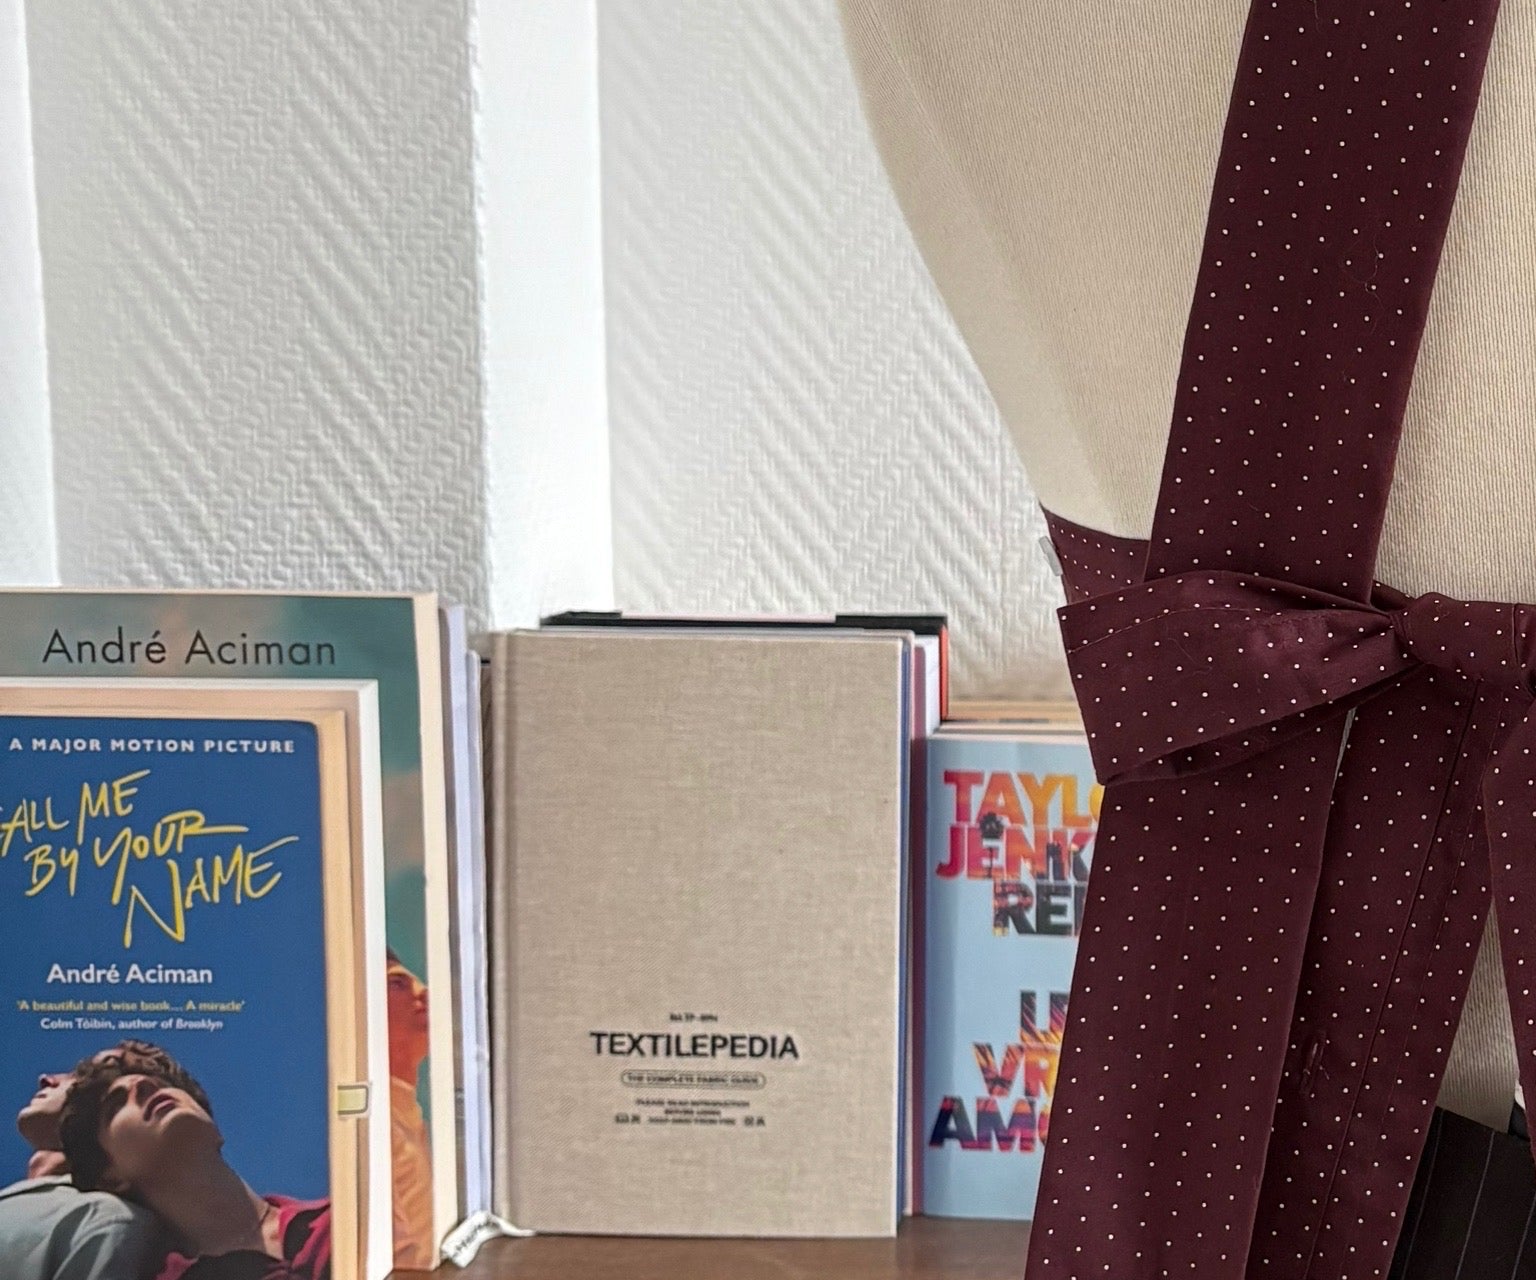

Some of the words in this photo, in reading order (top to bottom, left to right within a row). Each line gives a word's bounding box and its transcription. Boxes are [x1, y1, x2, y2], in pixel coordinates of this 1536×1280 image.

[42, 626, 166, 663] André
[184, 629, 336, 665] Aciman
[9, 738, 22, 751] A
[32, 738, 101, 754] MAJOR
[110, 738, 195, 753] MOTION
[204, 739, 295, 754] PICTURE
[78, 769, 151, 846] ME
[23, 844, 79, 897] BY
[93, 810, 249, 906] YOUR
[123, 836, 300, 949] NAME
[47, 963, 120, 984] André
[125, 963, 213, 984] Aciman
[32, 1000, 84, 1012] beautiful
[86, 1000, 108, 1012] and
[111, 1001, 138, 1012] wise
[185, 1001, 196, 1012] A
[40, 1018, 73, 1030] Colm
[118, 1019, 157, 1031] author
[160, 1018, 174, 1031] of
[175, 1019, 224, 1032] Brooklyn
[590, 1031, 800, 1060] TEXTILEPEDIA
